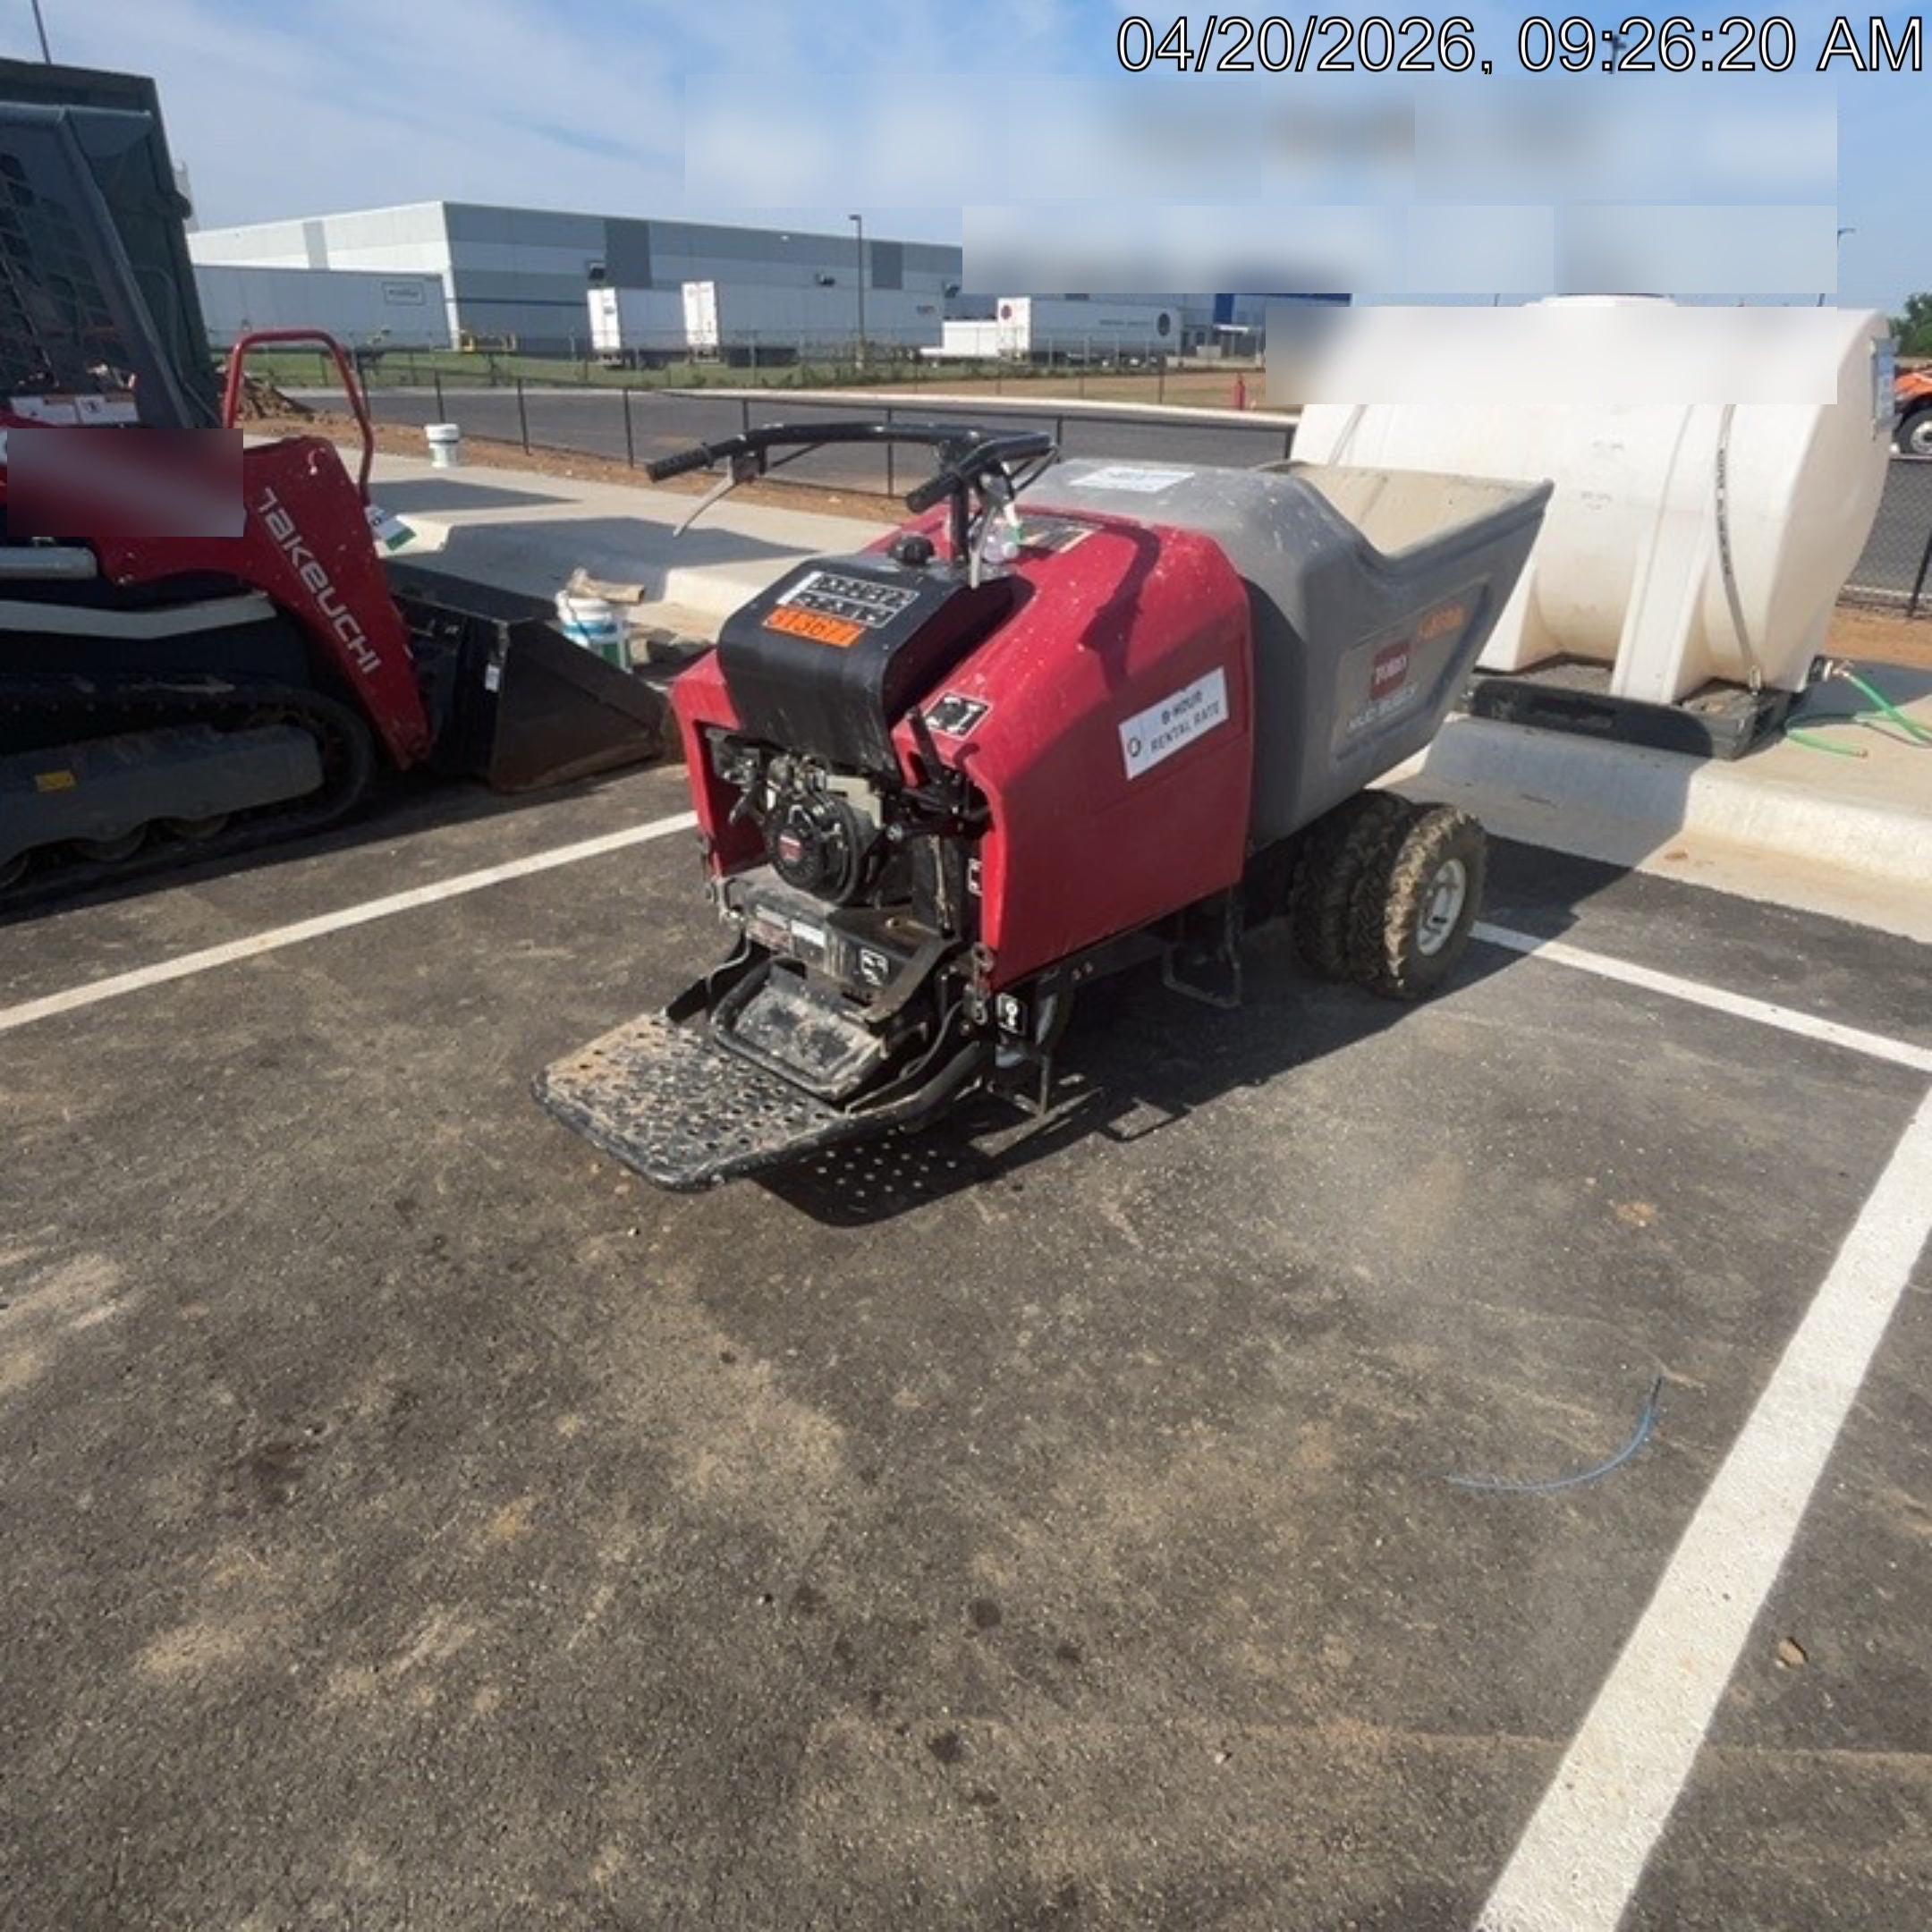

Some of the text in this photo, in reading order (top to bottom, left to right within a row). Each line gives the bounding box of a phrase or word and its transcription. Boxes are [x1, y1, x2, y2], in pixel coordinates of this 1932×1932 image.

[258, 487, 382, 674] TAKEUCHI
[1150, 699, 1218, 752] RENTAL RATE
